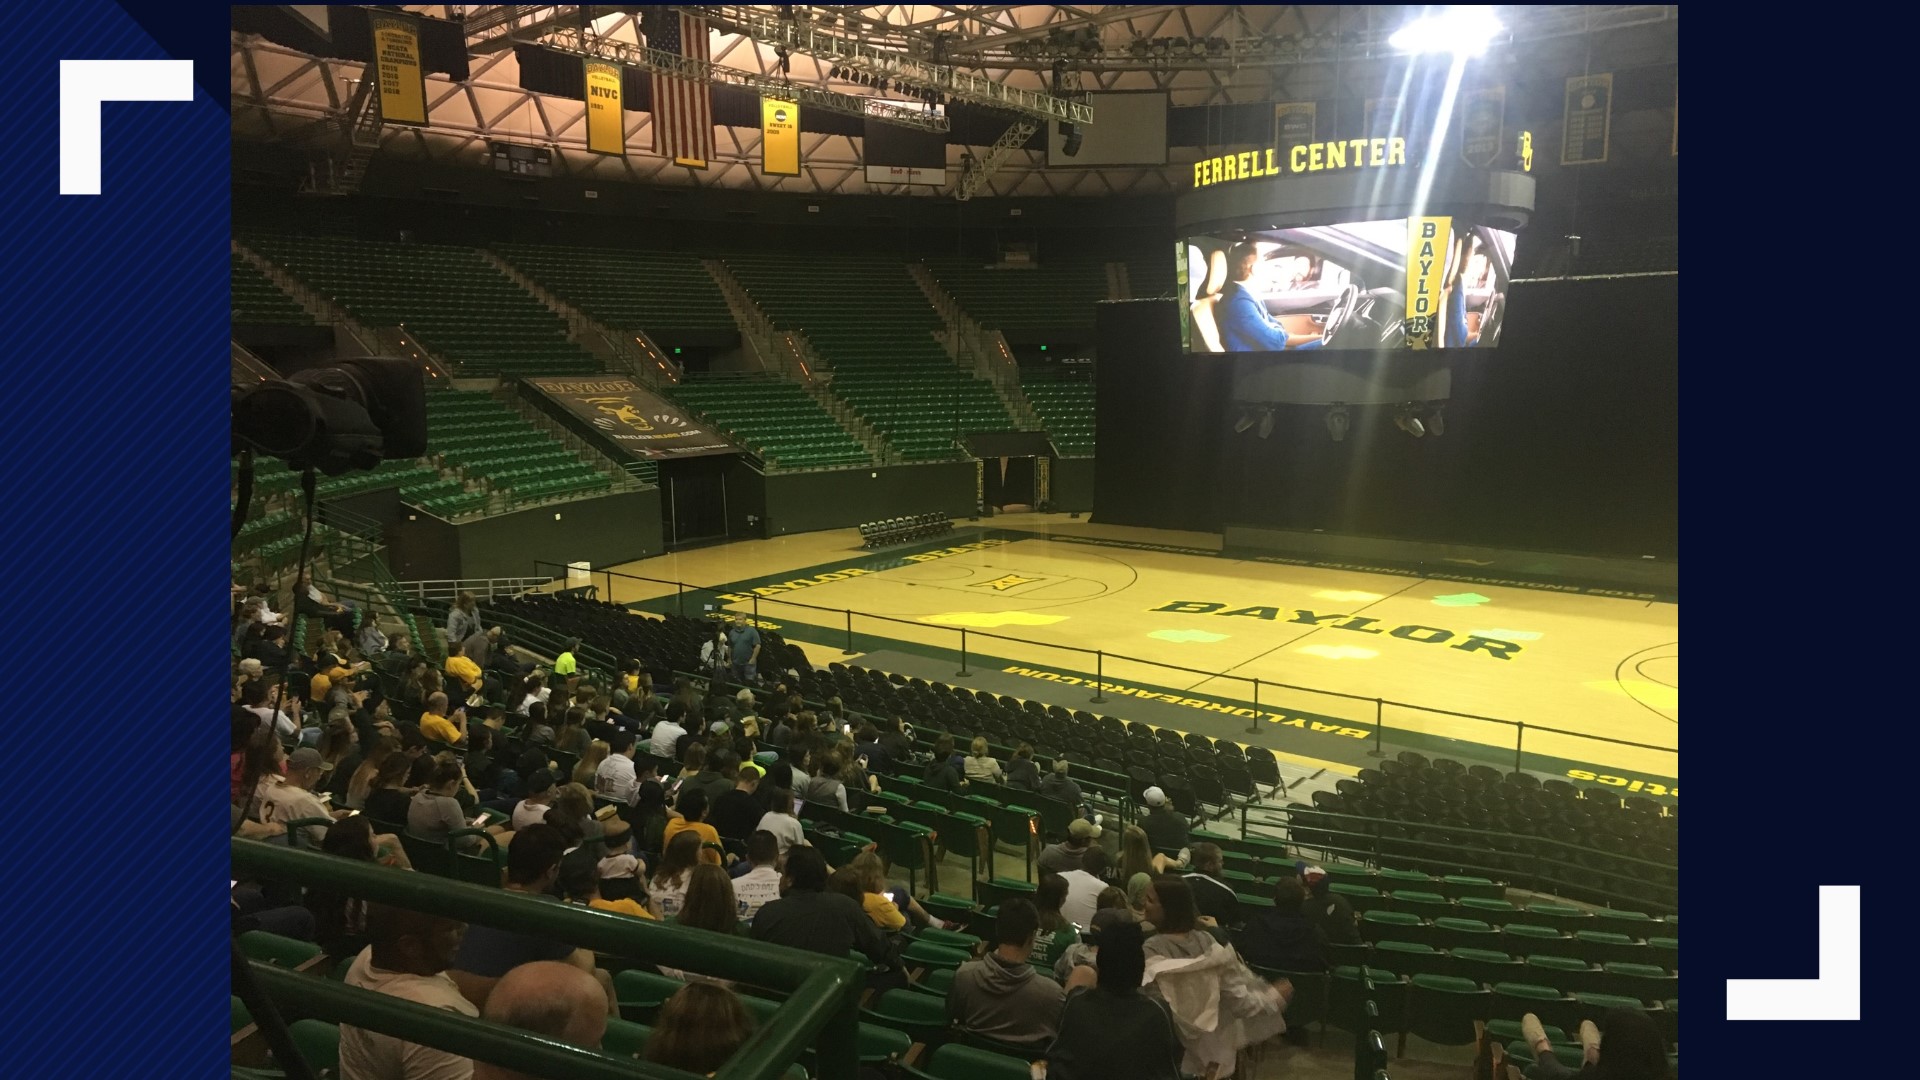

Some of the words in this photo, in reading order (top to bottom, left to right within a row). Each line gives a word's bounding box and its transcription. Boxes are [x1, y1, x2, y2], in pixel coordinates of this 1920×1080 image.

[380, 56, 417, 67] CHAMPIONS
[382, 50, 415, 60] NATIONAL
[383, 79, 400, 87] 2017
[590, 85, 618, 100] NIVC
[1194, 149, 1279, 188] FERRELL
[1291, 137, 1406, 173] CENTER
[1411, 222, 1437, 333] BAYLOR
[536, 380, 641, 394] BAYLOR
[715, 567, 876, 603] BAYLOR
[902, 539, 1011, 562] BEARS
[1313, 561, 1420, 577] NATIONAL
[1427, 573, 1580, 592] CHAMPIONS
[1147, 600, 1524, 661] BAYLOR
[1002, 665, 1372, 740] BAYLORBEARS.COM
